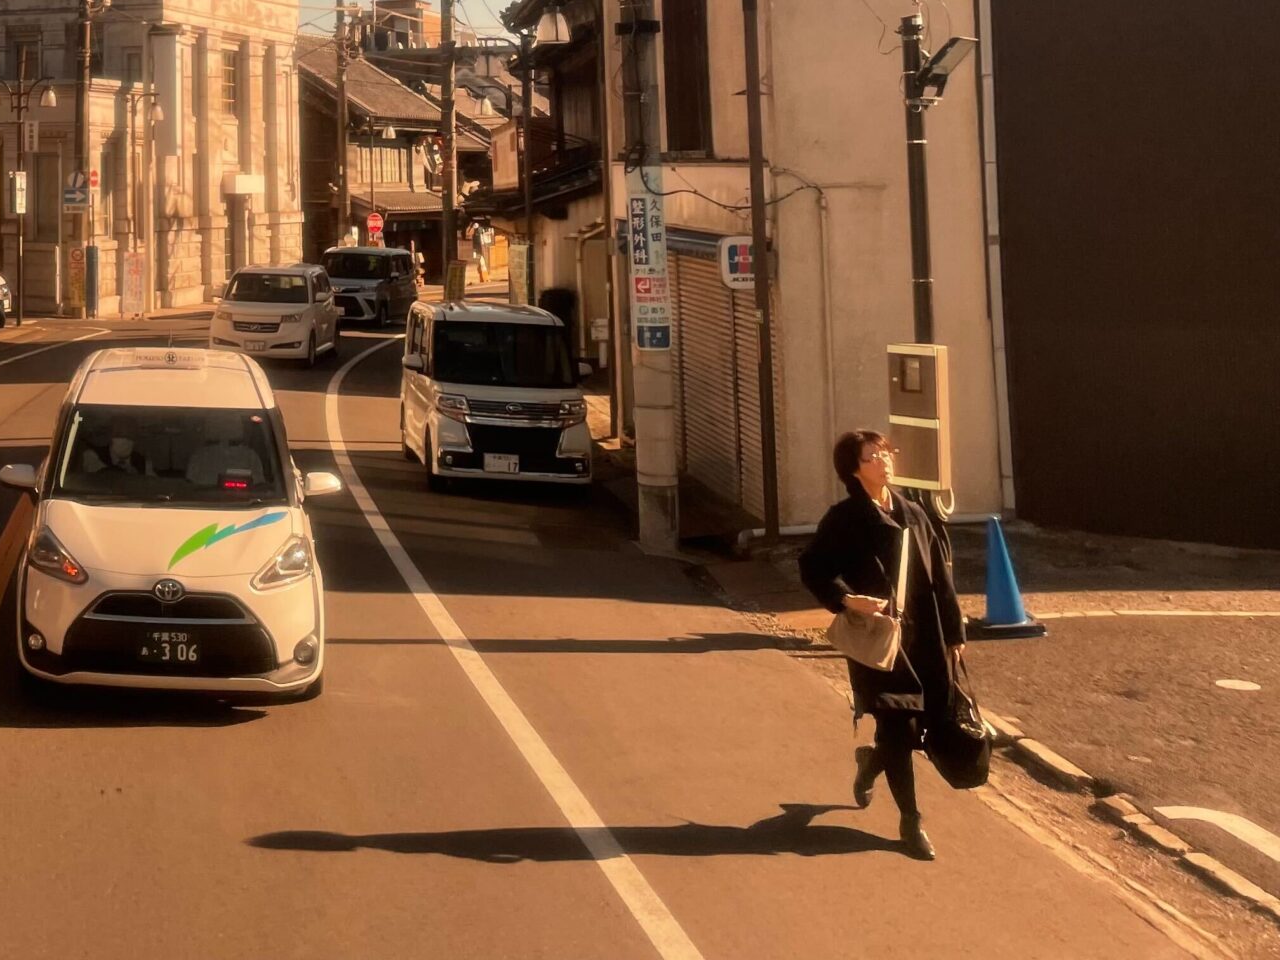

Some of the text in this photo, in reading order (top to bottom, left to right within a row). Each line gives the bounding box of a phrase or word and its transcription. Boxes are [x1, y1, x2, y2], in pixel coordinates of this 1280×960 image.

[631, 199, 649, 264] 整形外科
[649, 198, 662, 242] 久保田
